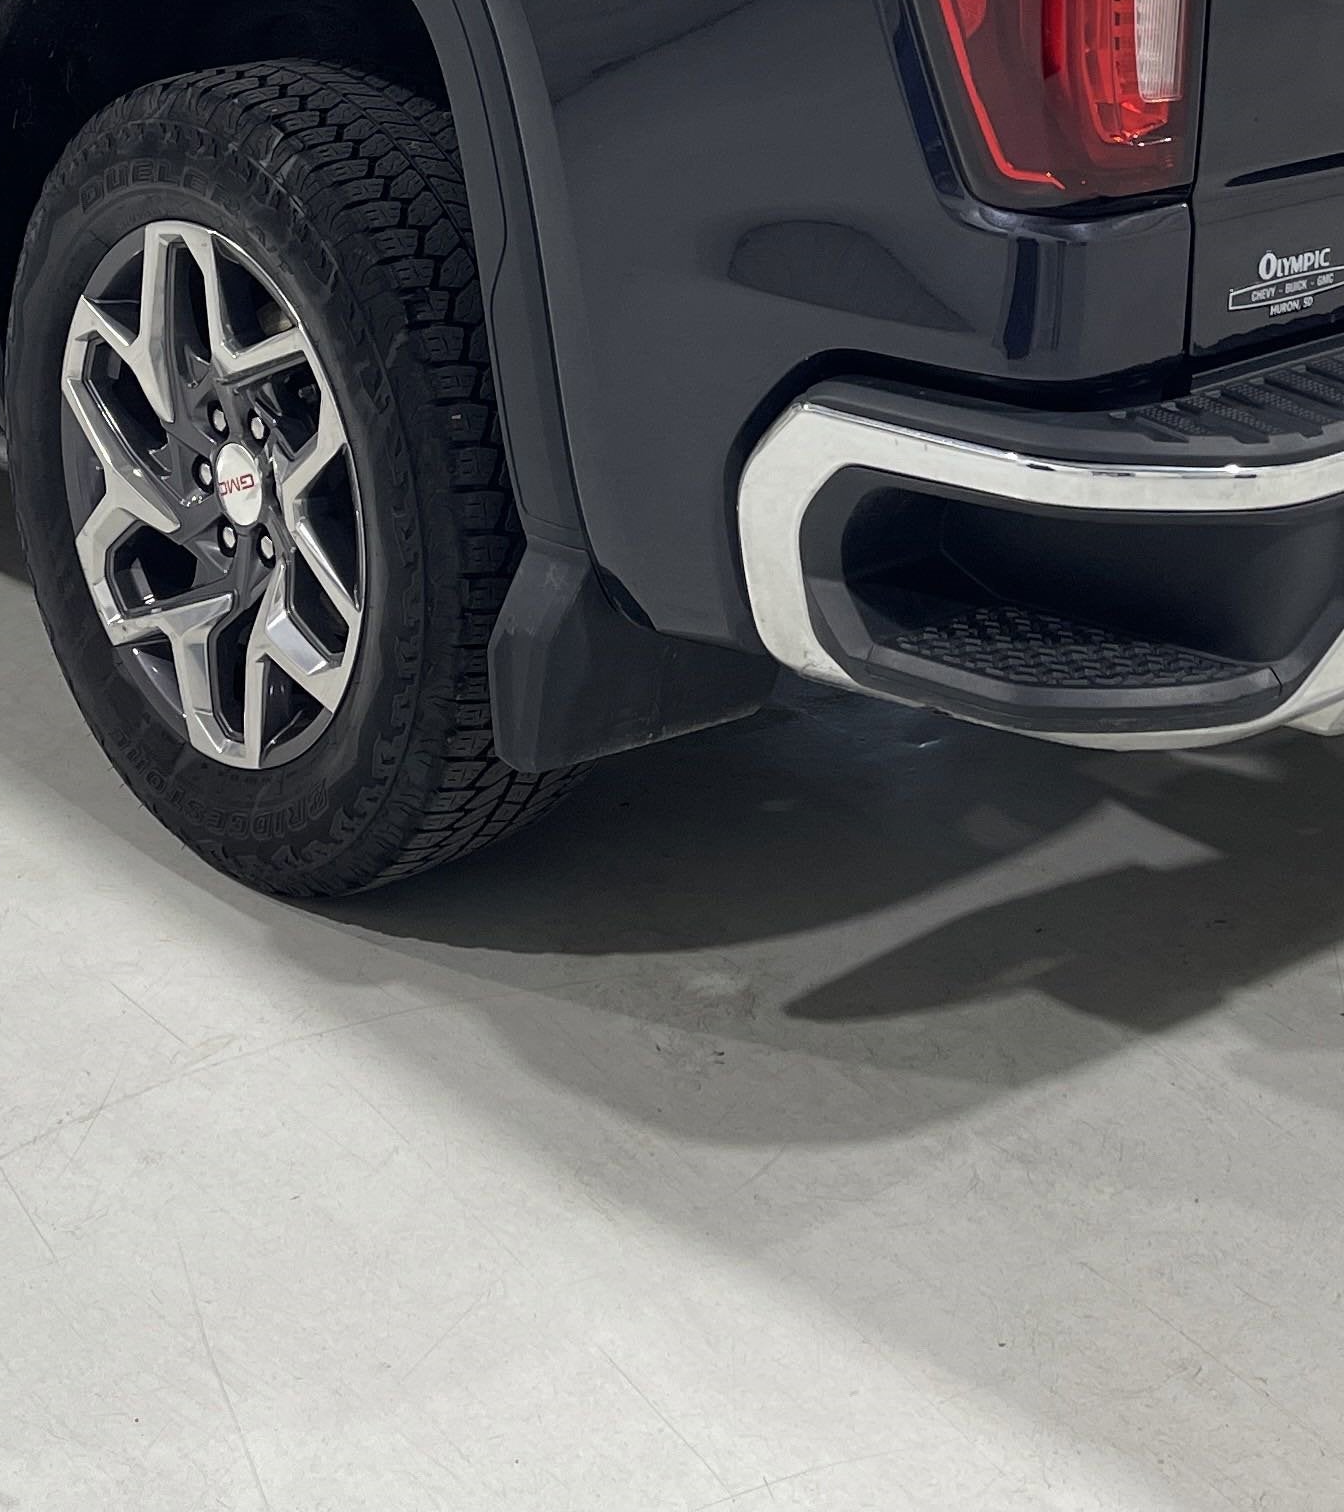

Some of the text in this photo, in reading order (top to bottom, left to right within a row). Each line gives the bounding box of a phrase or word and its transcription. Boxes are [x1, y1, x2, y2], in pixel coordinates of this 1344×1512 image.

[1258, 249, 1331, 280] OLYMPIC
[1251, 286, 1276, 302] CHEVY
[1285, 279, 1308, 294] BUICK
[1316, 273, 1334, 286] GMC
[1303, 296, 1313, 308] SD
[218, 473, 255, 497] GMC
